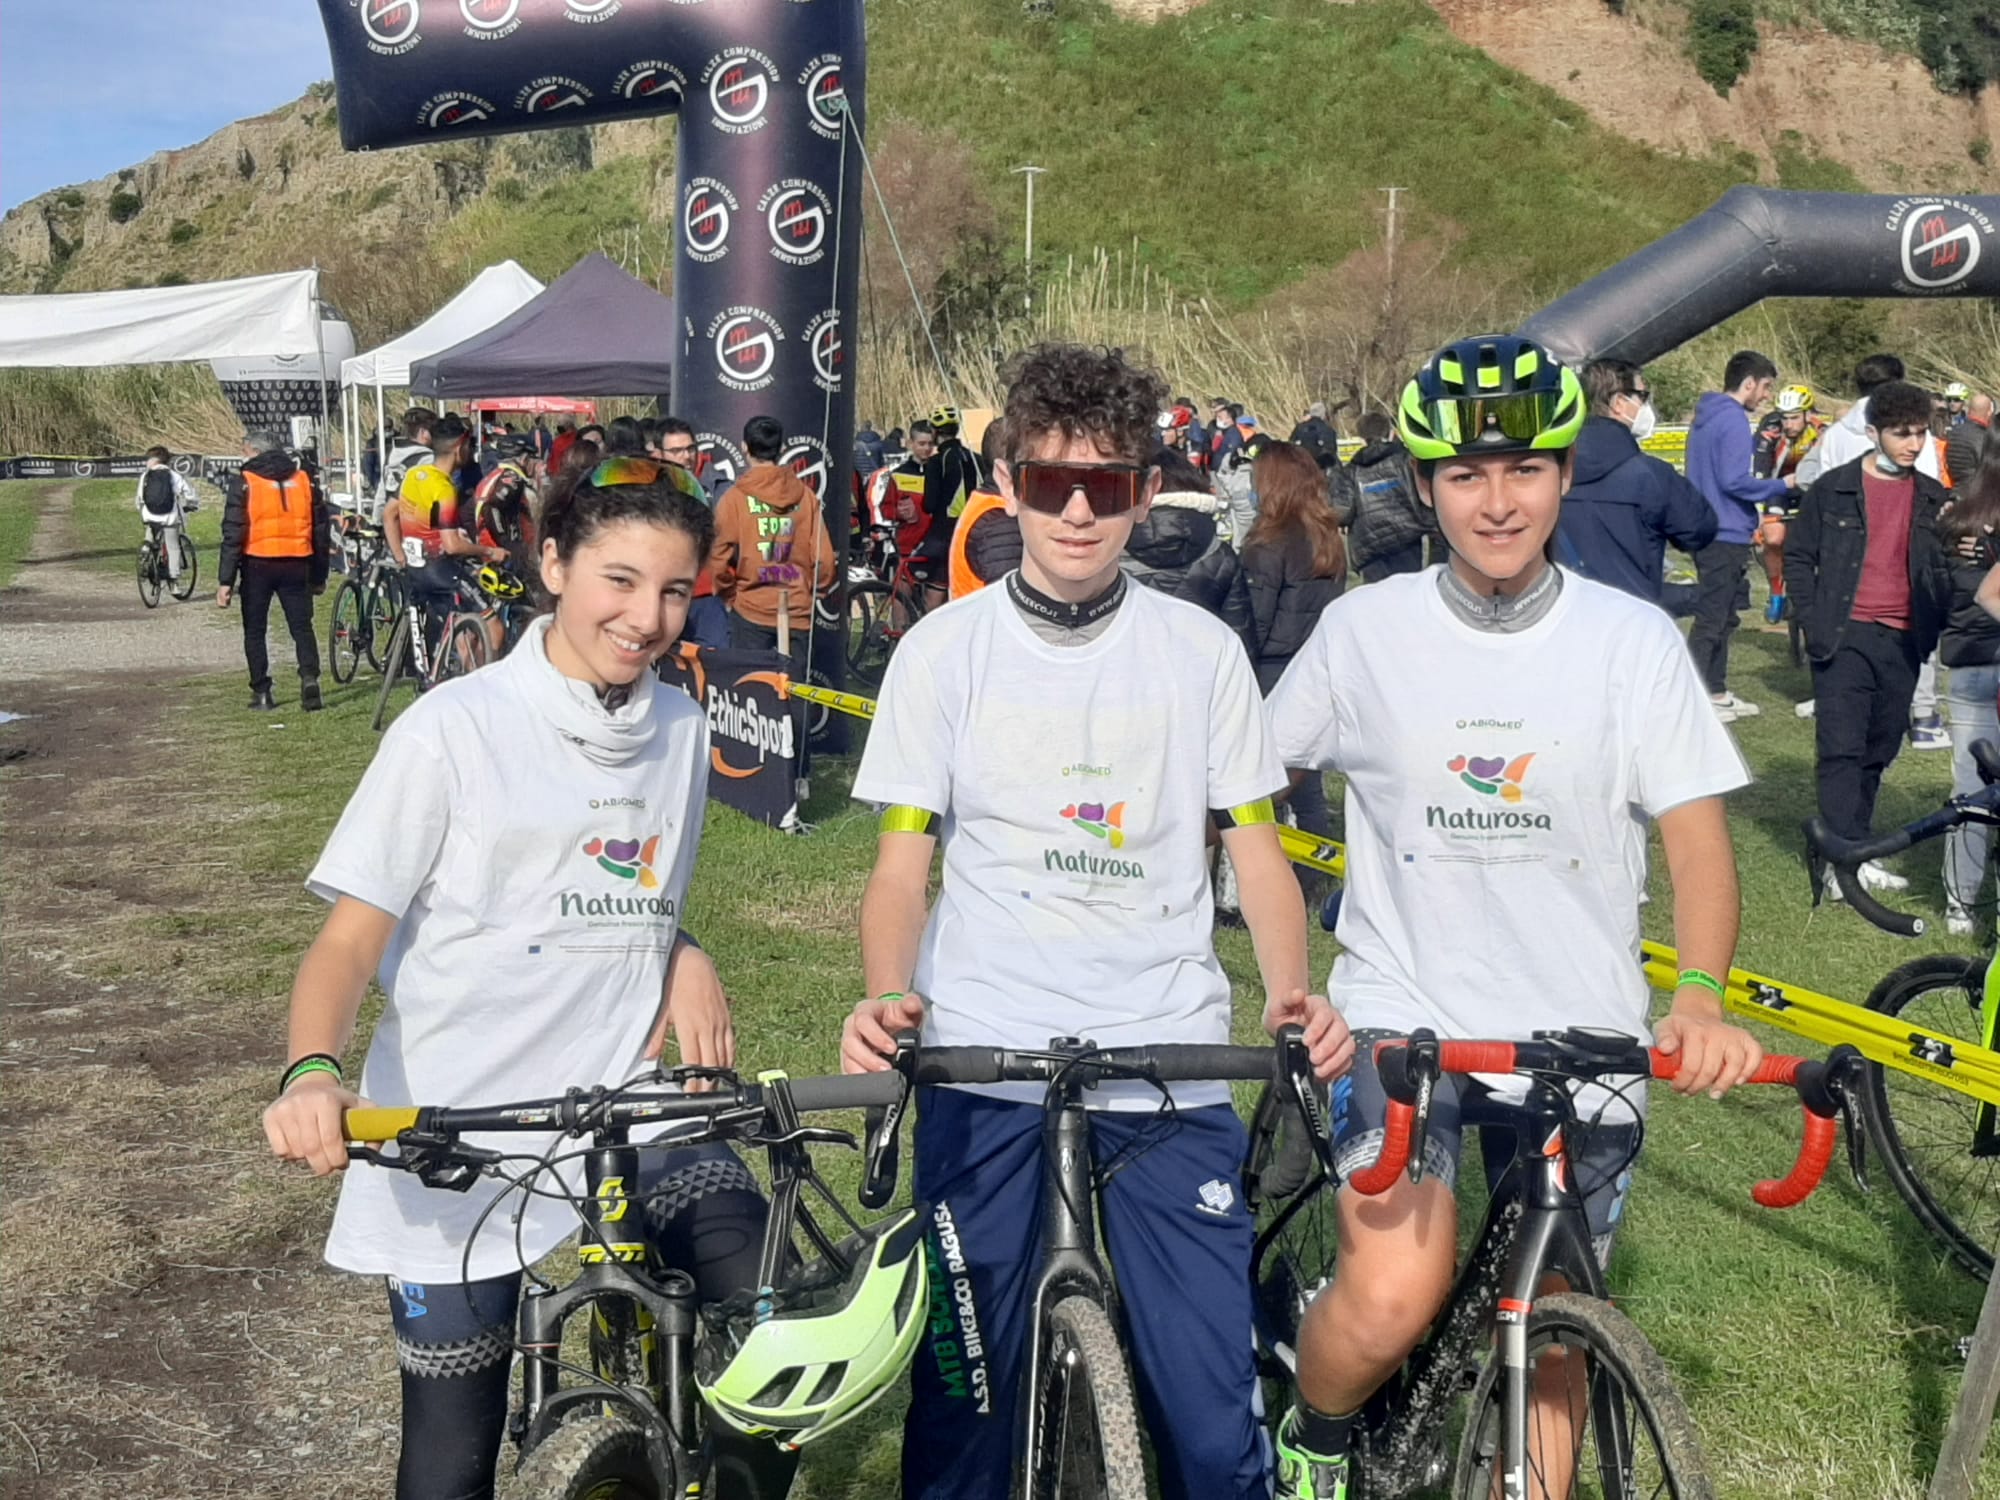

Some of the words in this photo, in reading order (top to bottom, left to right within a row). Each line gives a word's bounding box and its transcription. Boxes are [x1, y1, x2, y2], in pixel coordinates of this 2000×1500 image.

[563, 1, 623, 23] INNOVAZIONI
[463, 17, 522, 40] INNOVAZIONI
[367, 33, 422, 56] INNOVAZIONI
[611, 69, 630, 94] CALZE
[630, 60, 688, 85] COMPRESSION
[700, 53, 722, 84] CALZE
[723, 47, 780, 83] COMPRESSION
[798, 58, 818, 85] CALZE
[433, 92, 496, 113] COMPRESSION
[513, 83, 531, 110] CALZE
[532, 76, 595, 98] COMPRESSION
[711, 116, 768, 136] INNOVAZIONI
[757, 185, 780, 213] CALZE
[781, 179, 833, 215] COMPRESSION
[769, 246, 825, 266] INNOVAZIONI
[706, 311, 727, 339] CALZE
[728, 305, 786, 340] COMPRESSION
[801, 314, 823, 342] CALZE
[717, 373, 775, 392] INNOVAZIONI
[757, 517, 793, 537] FOR
[954, 1277, 984, 1358] BIKE&CO
[935, 1340, 967, 1396] MTB
